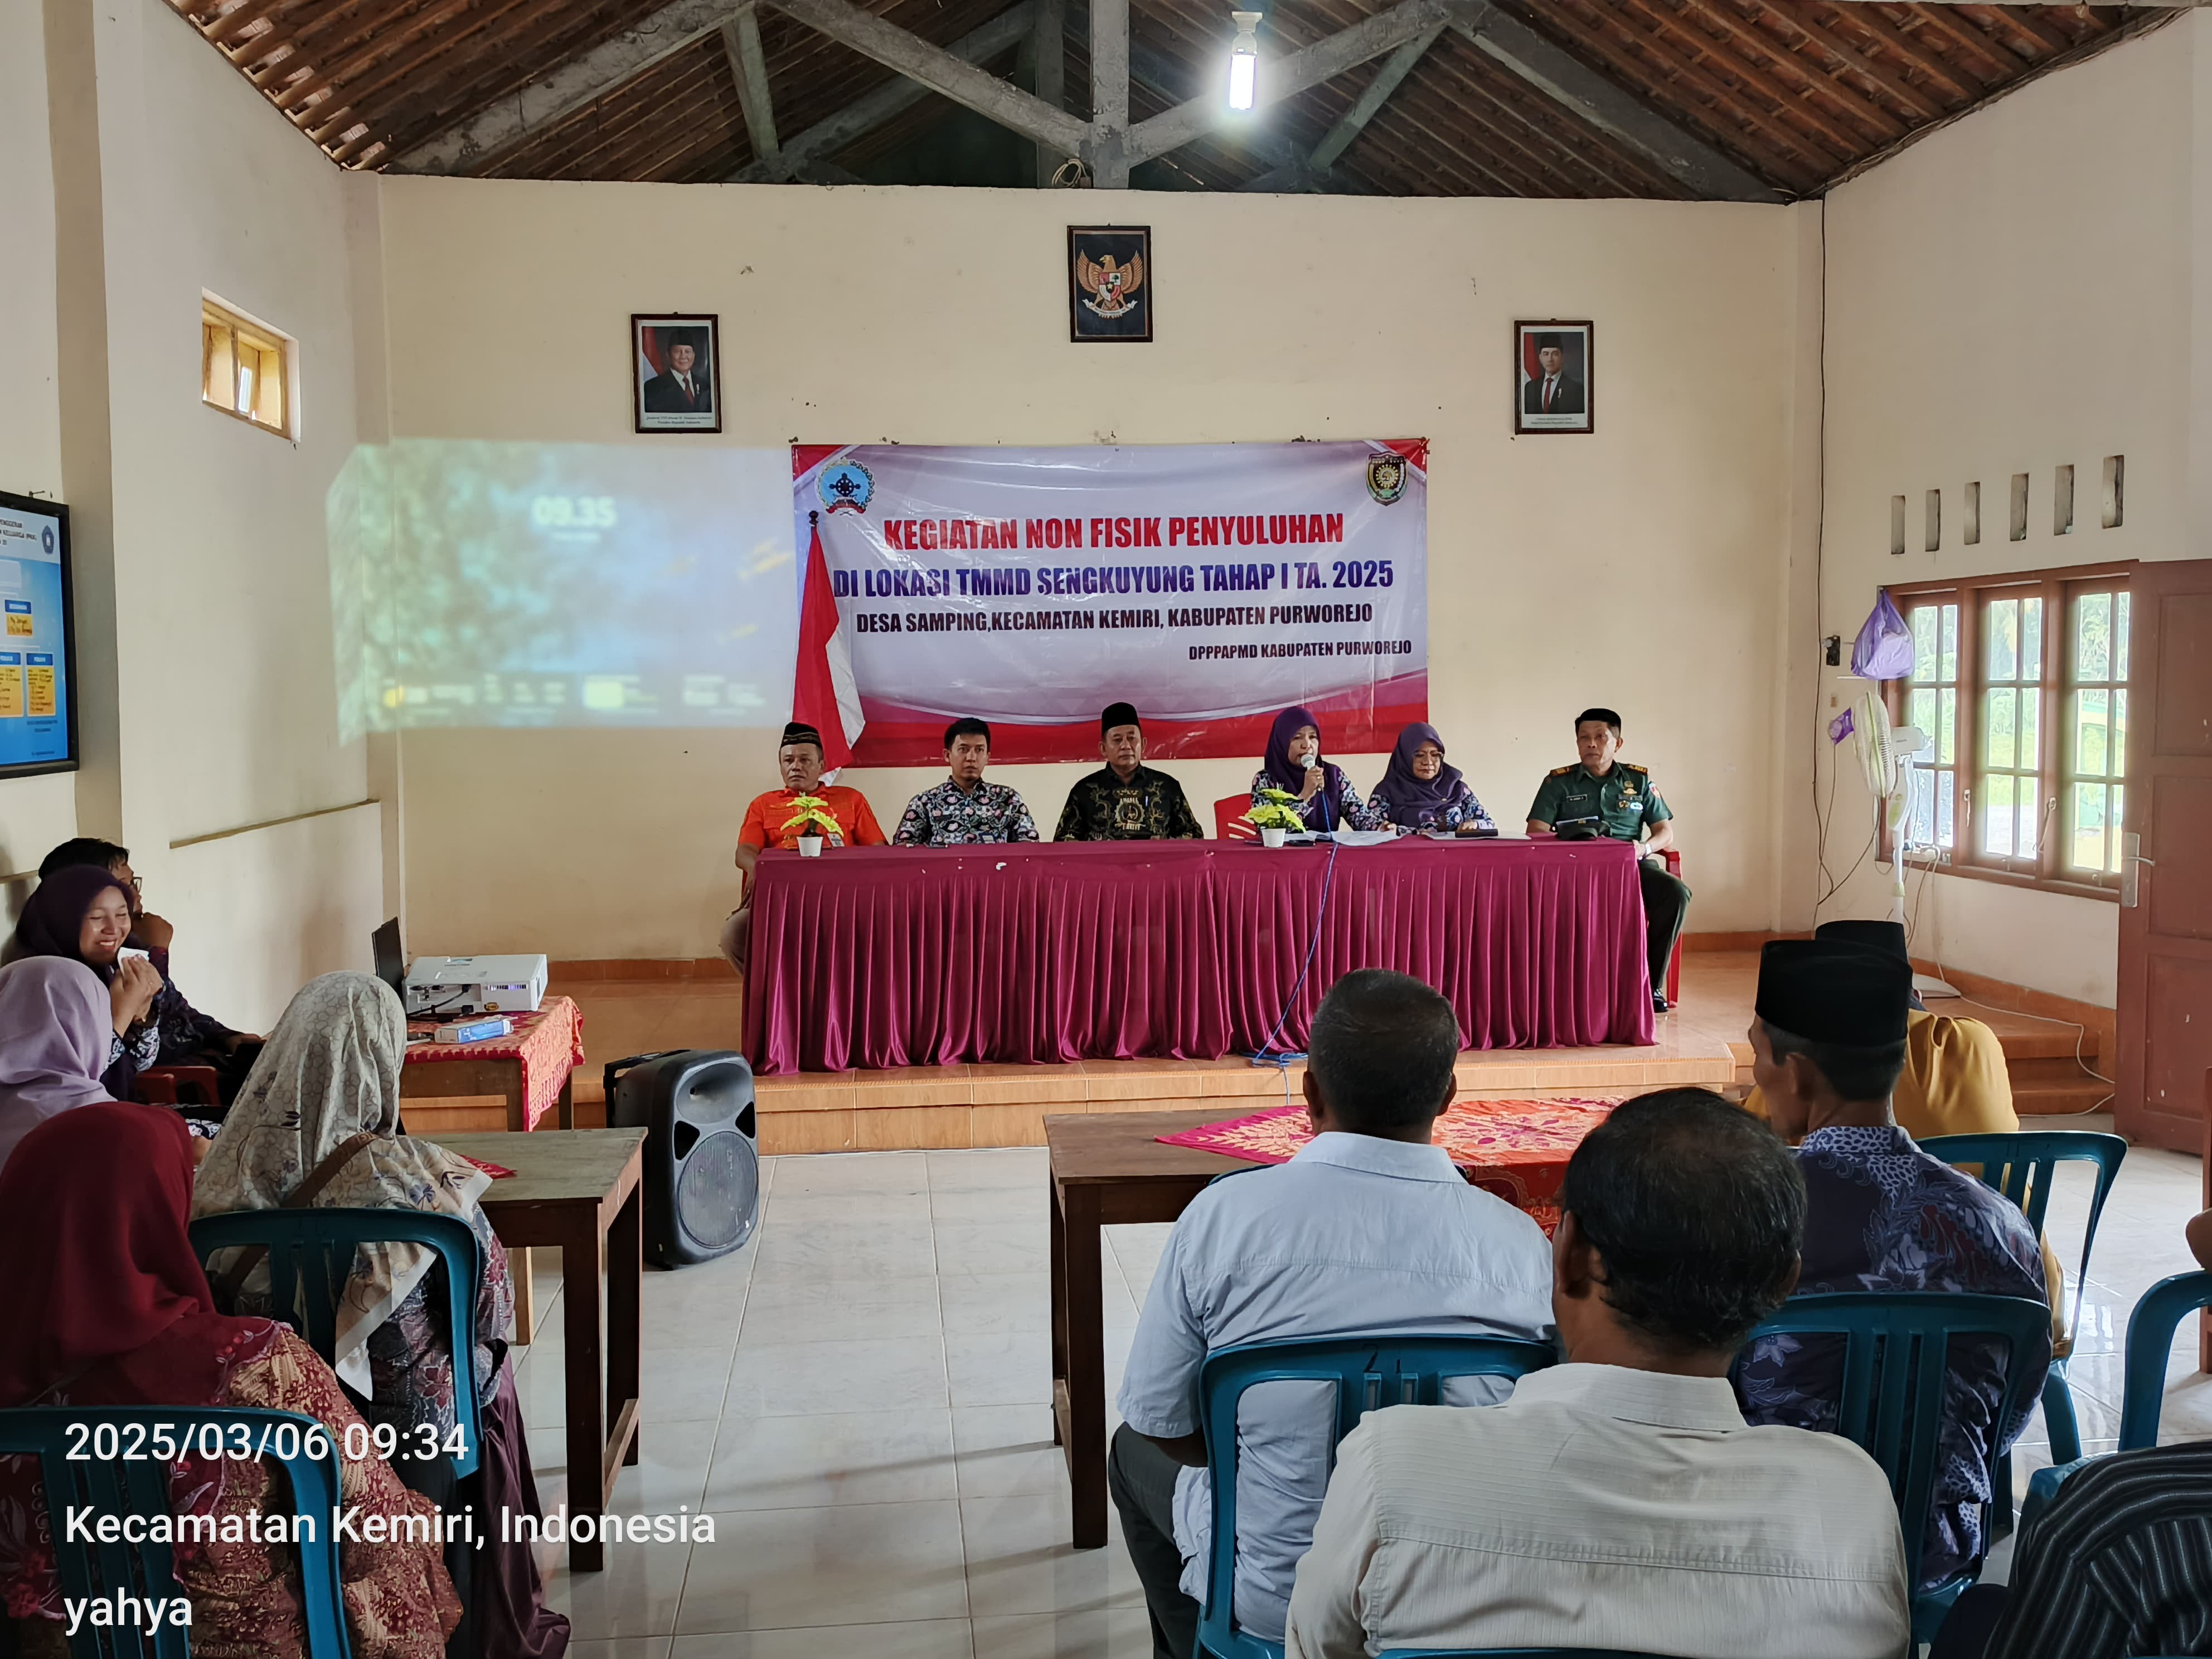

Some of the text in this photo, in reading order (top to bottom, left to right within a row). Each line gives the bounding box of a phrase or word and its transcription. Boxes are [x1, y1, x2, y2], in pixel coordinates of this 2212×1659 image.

[885, 515, 1343, 550] KEGIATAN NON FISIK PENYULUHAN
[833, 560, 1393, 598] DI LOKASI TMMD SENGKUYUNG TAHAP I TA. 2025
[857, 614, 901, 632] DESA
[1099, 609, 1163, 629] KEMIRI,
[1168, 607, 1265, 627] KABUPATEN
[1270, 604, 1372, 624] PURWOREJO
[1190, 640, 1411, 659] DPPPAPMD KABUPATEN PURWOREJO
